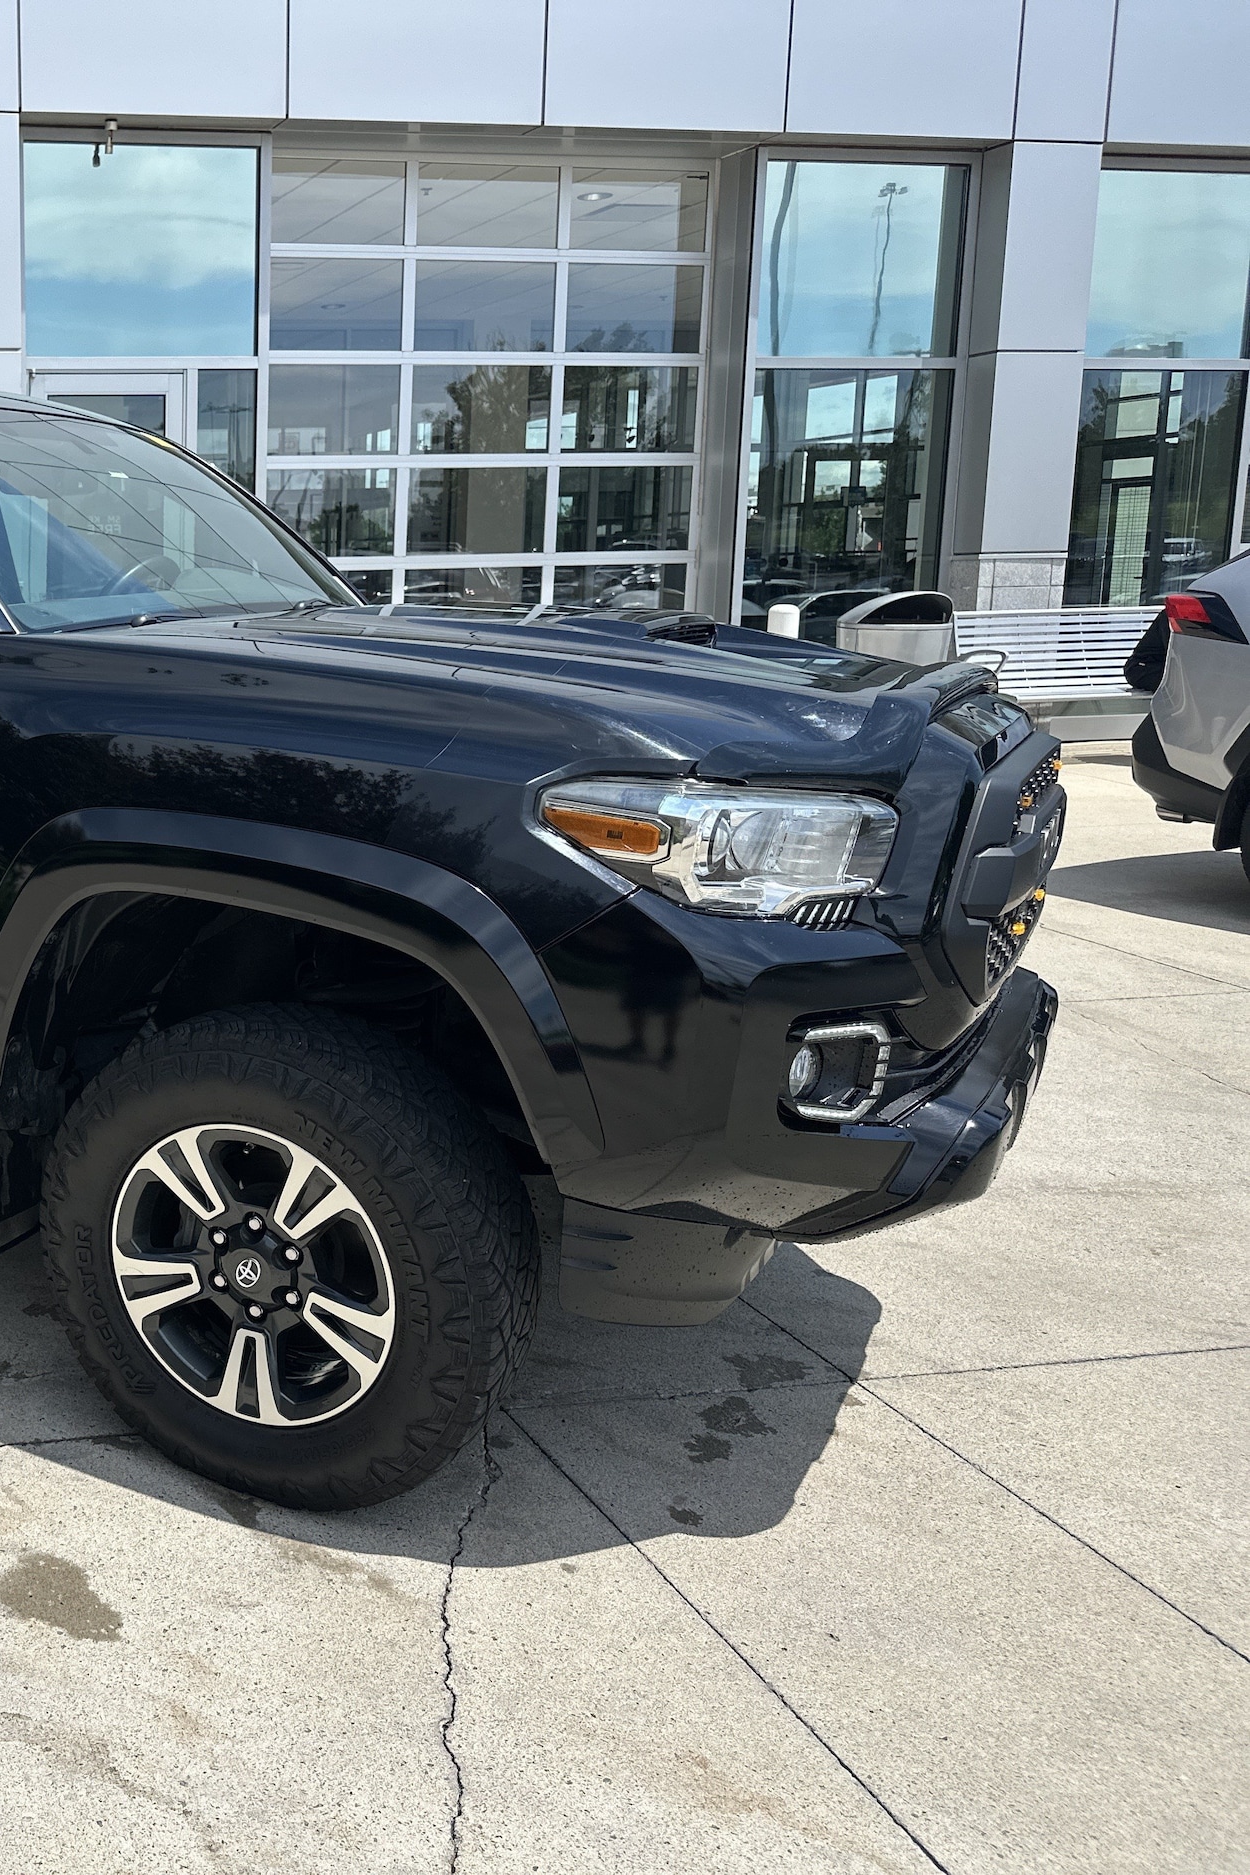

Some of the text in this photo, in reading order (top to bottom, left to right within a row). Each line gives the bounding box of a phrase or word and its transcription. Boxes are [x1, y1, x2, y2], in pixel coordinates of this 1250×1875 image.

[75, 1225, 147, 1390] PREDATOR
[294, 1110, 366, 1176] NEW
[362, 1175, 430, 1344] MUTANT
